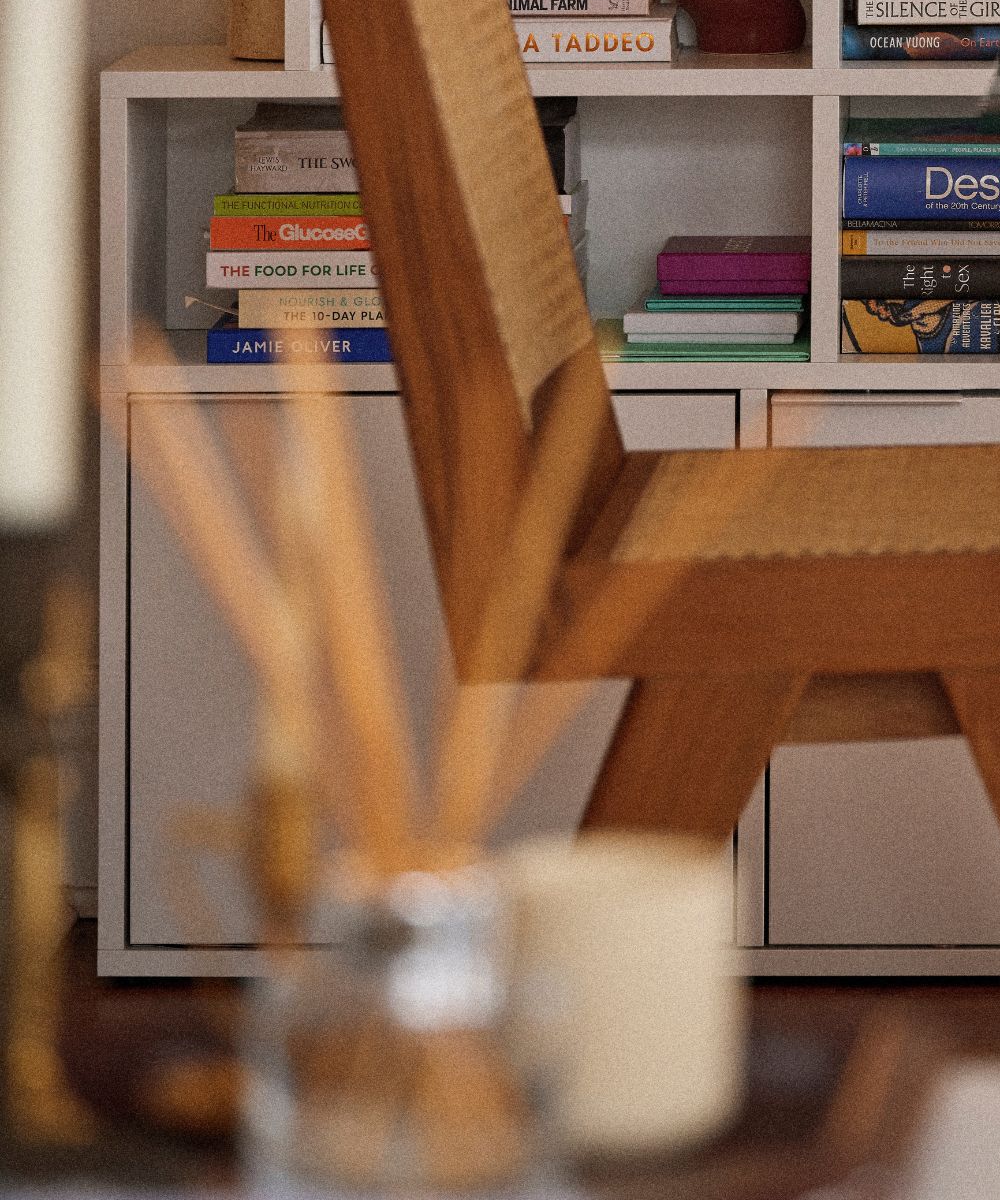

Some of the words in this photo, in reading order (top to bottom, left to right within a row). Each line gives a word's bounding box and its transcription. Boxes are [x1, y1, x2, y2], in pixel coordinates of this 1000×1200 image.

[865, 0, 874, 18] THE
[876, 1, 947, 18] SILENCE
[950, 2, 959, 16] OF
[959, 0, 968, 19] THE
[522, 32, 540, 53] A
[551, 31, 656, 53] TADDEO
[870, 37, 903, 49] OCEAN
[906, 36, 940, 49] VUONG
[960, 38, 977, 48] On
[258, 156, 280, 164] LEWIS
[297, 157, 328, 169] THE
[250, 165, 288, 173] HAYWARD
[222, 201, 241, 210] THE
[243, 201, 299, 211] FUNCTIONAL
[301, 201, 352, 211] NUTRITION
[925, 202, 934, 211] of
[935, 202, 949, 211] the
[950, 202, 969, 211] 20th
[847, 220, 898, 228] BELLAMACINA
[253, 224, 277, 242] The
[220, 265, 250, 277] THE
[254, 265, 298, 277] FOOD
[302, 265, 332, 276] FOR
[336, 265, 366, 276] LIFE
[902, 263, 916, 289] The
[920, 264, 938, 296] Right
[954, 264, 970, 293] Sex
[279, 297, 336, 307] NOURISH
[340, 297, 349, 306] &
[284, 311, 307, 321] THE
[312, 311, 356, 321] 10-DAY
[952, 302, 961, 336] AMAZING
[962, 303, 971, 348] ADVENTURES
[980, 302, 992, 350] KAVALIER
[232, 341, 284, 354] JAMIE
[290, 340, 352, 353] OLIVER
